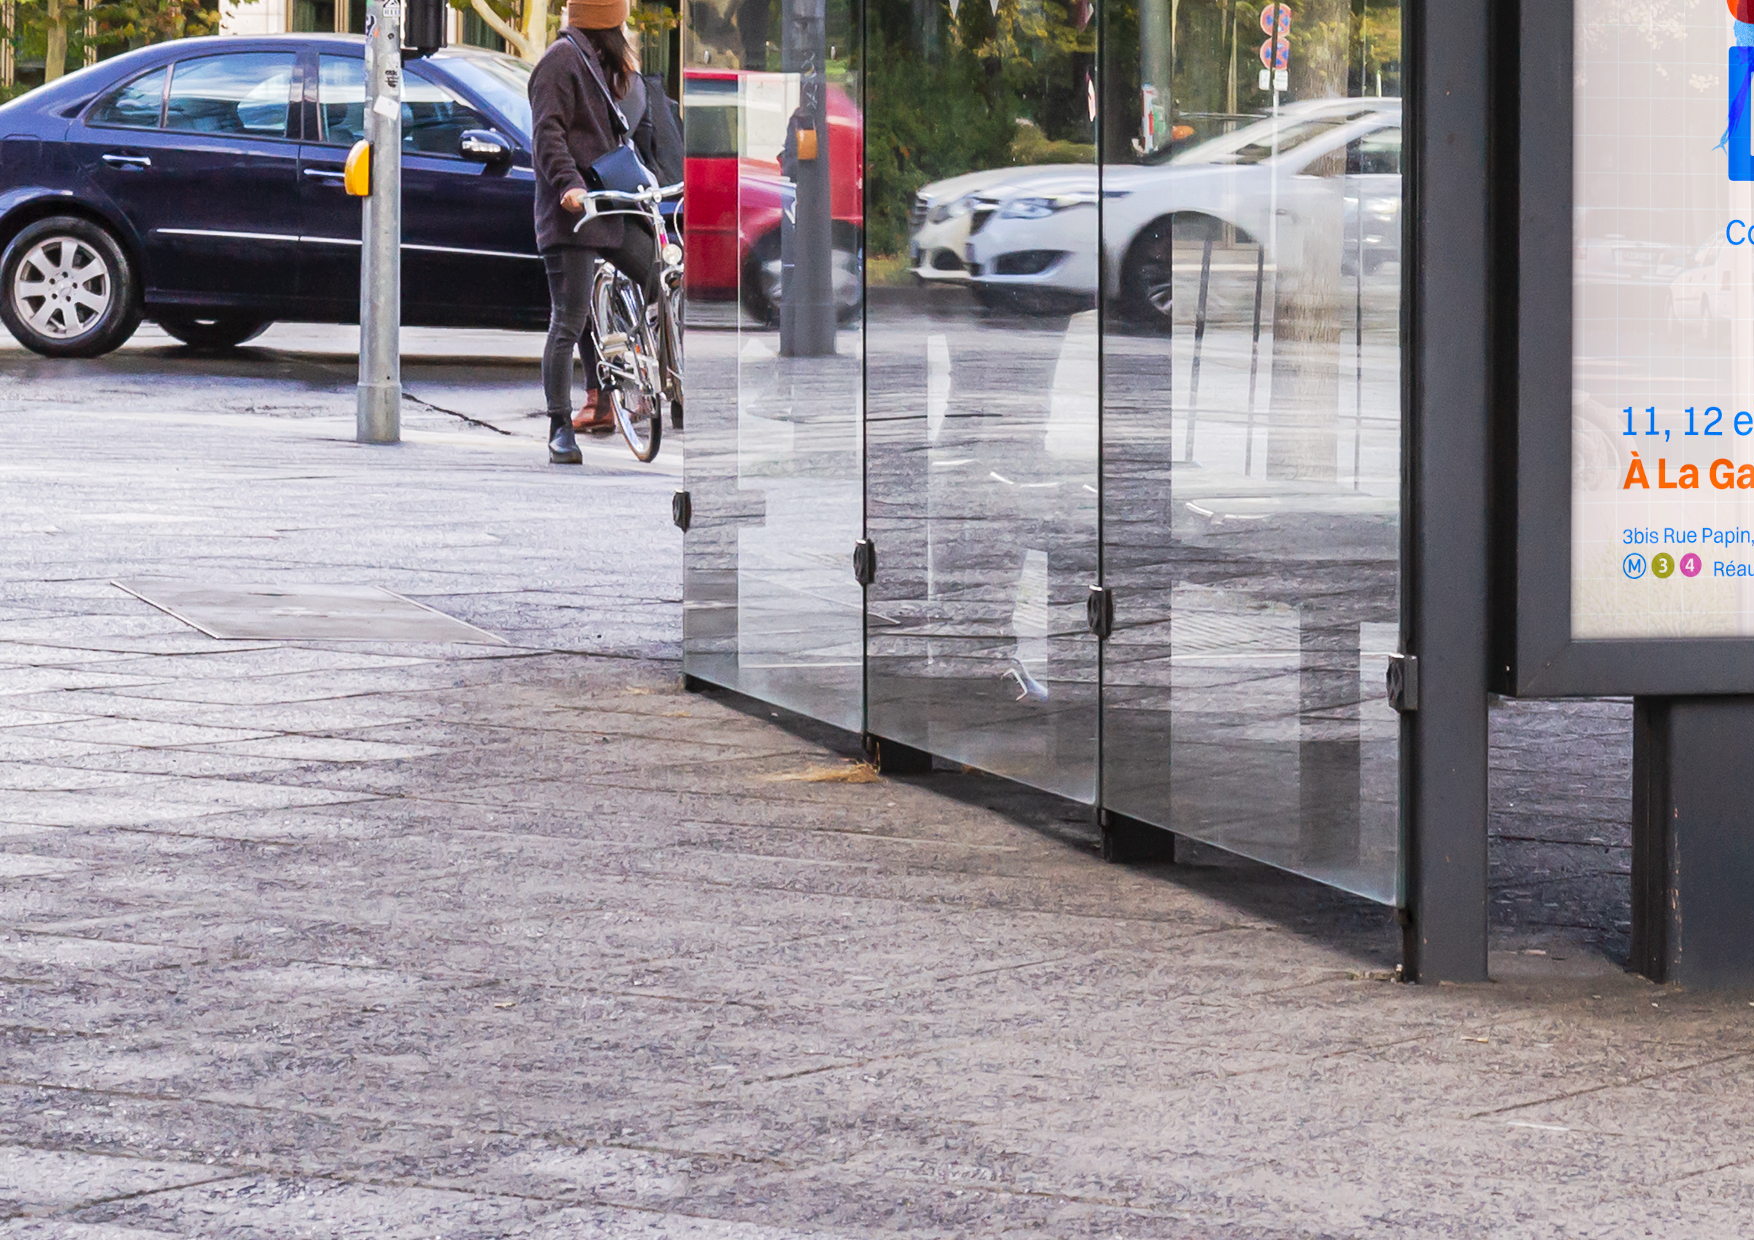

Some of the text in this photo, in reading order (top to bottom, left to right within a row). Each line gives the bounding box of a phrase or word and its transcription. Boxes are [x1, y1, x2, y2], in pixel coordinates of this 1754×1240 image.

[1623, 407, 1670, 442] 11,
[1685, 407, 1722, 435] 12
[1623, 451, 1650, 489] À
[1659, 458, 1699, 489] La
[1623, 528, 1658, 544] 3bis
[1664, 528, 1697, 543] Rue
[1703, 527, 1754, 548] Papin,
